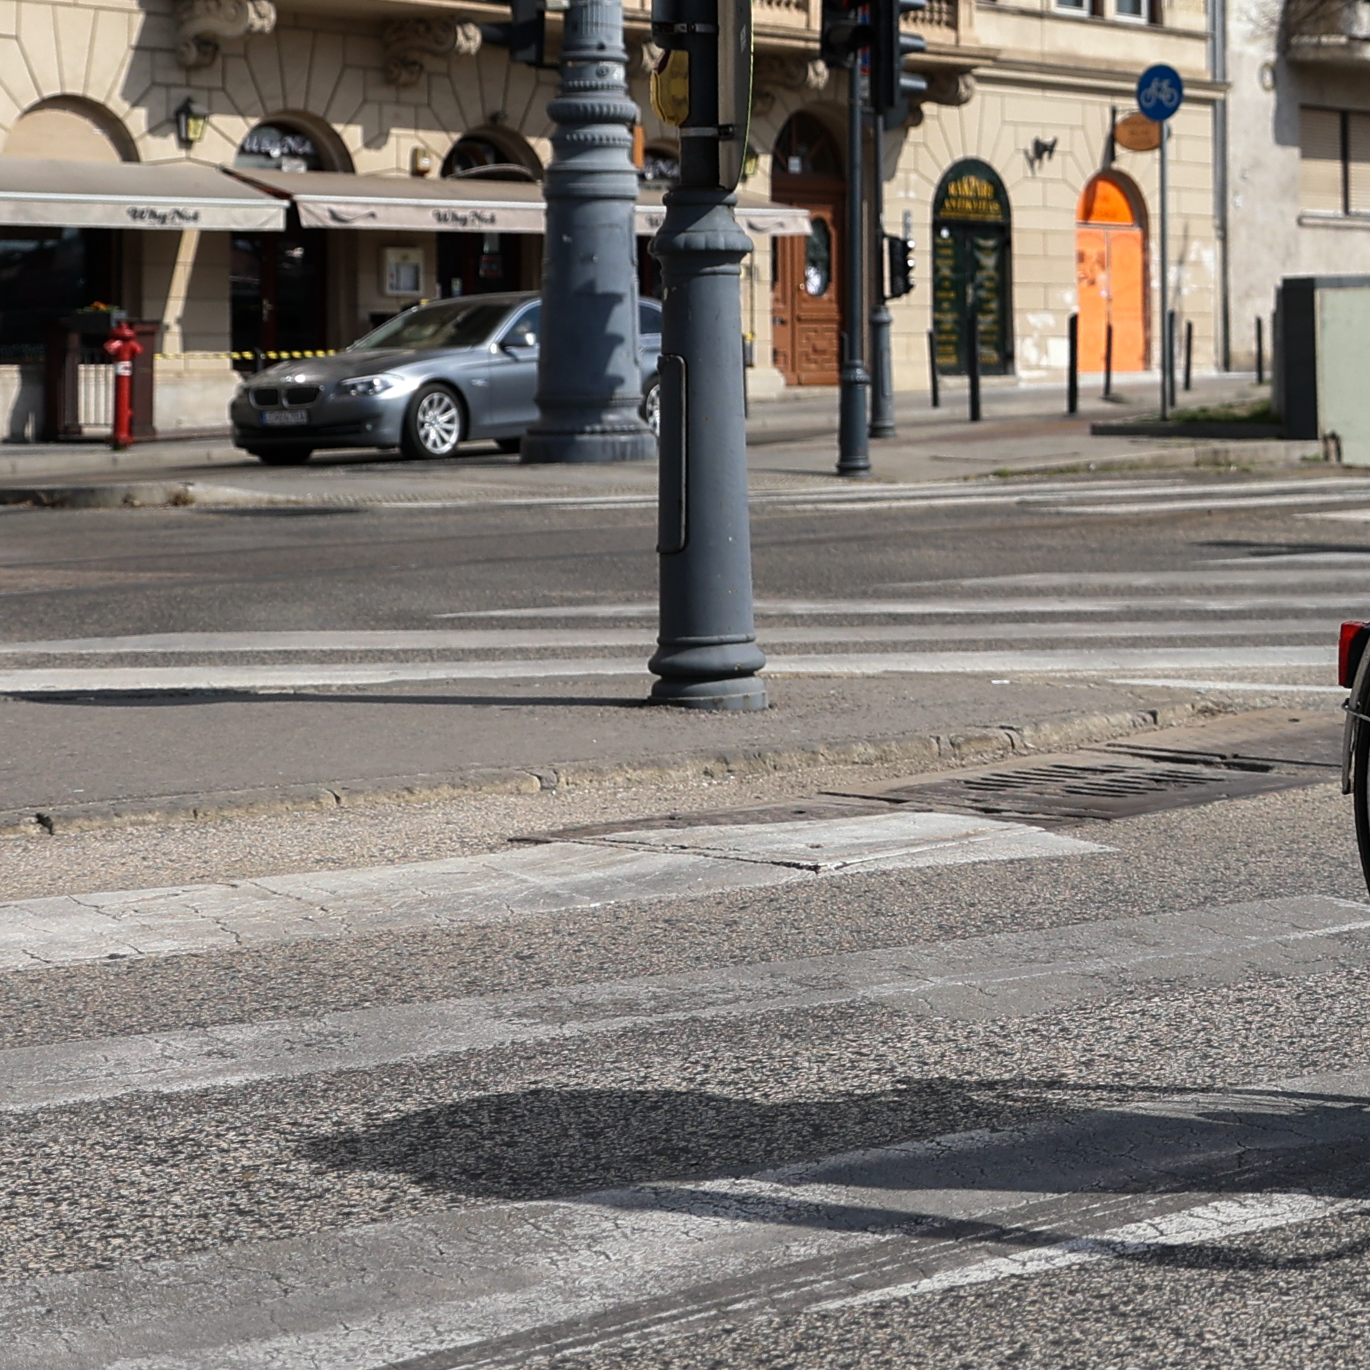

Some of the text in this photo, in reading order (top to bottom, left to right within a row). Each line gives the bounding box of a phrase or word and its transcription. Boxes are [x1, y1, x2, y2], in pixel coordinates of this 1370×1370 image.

[126, 207, 200, 225] Why Not
[431, 210, 496, 227] Why Not
